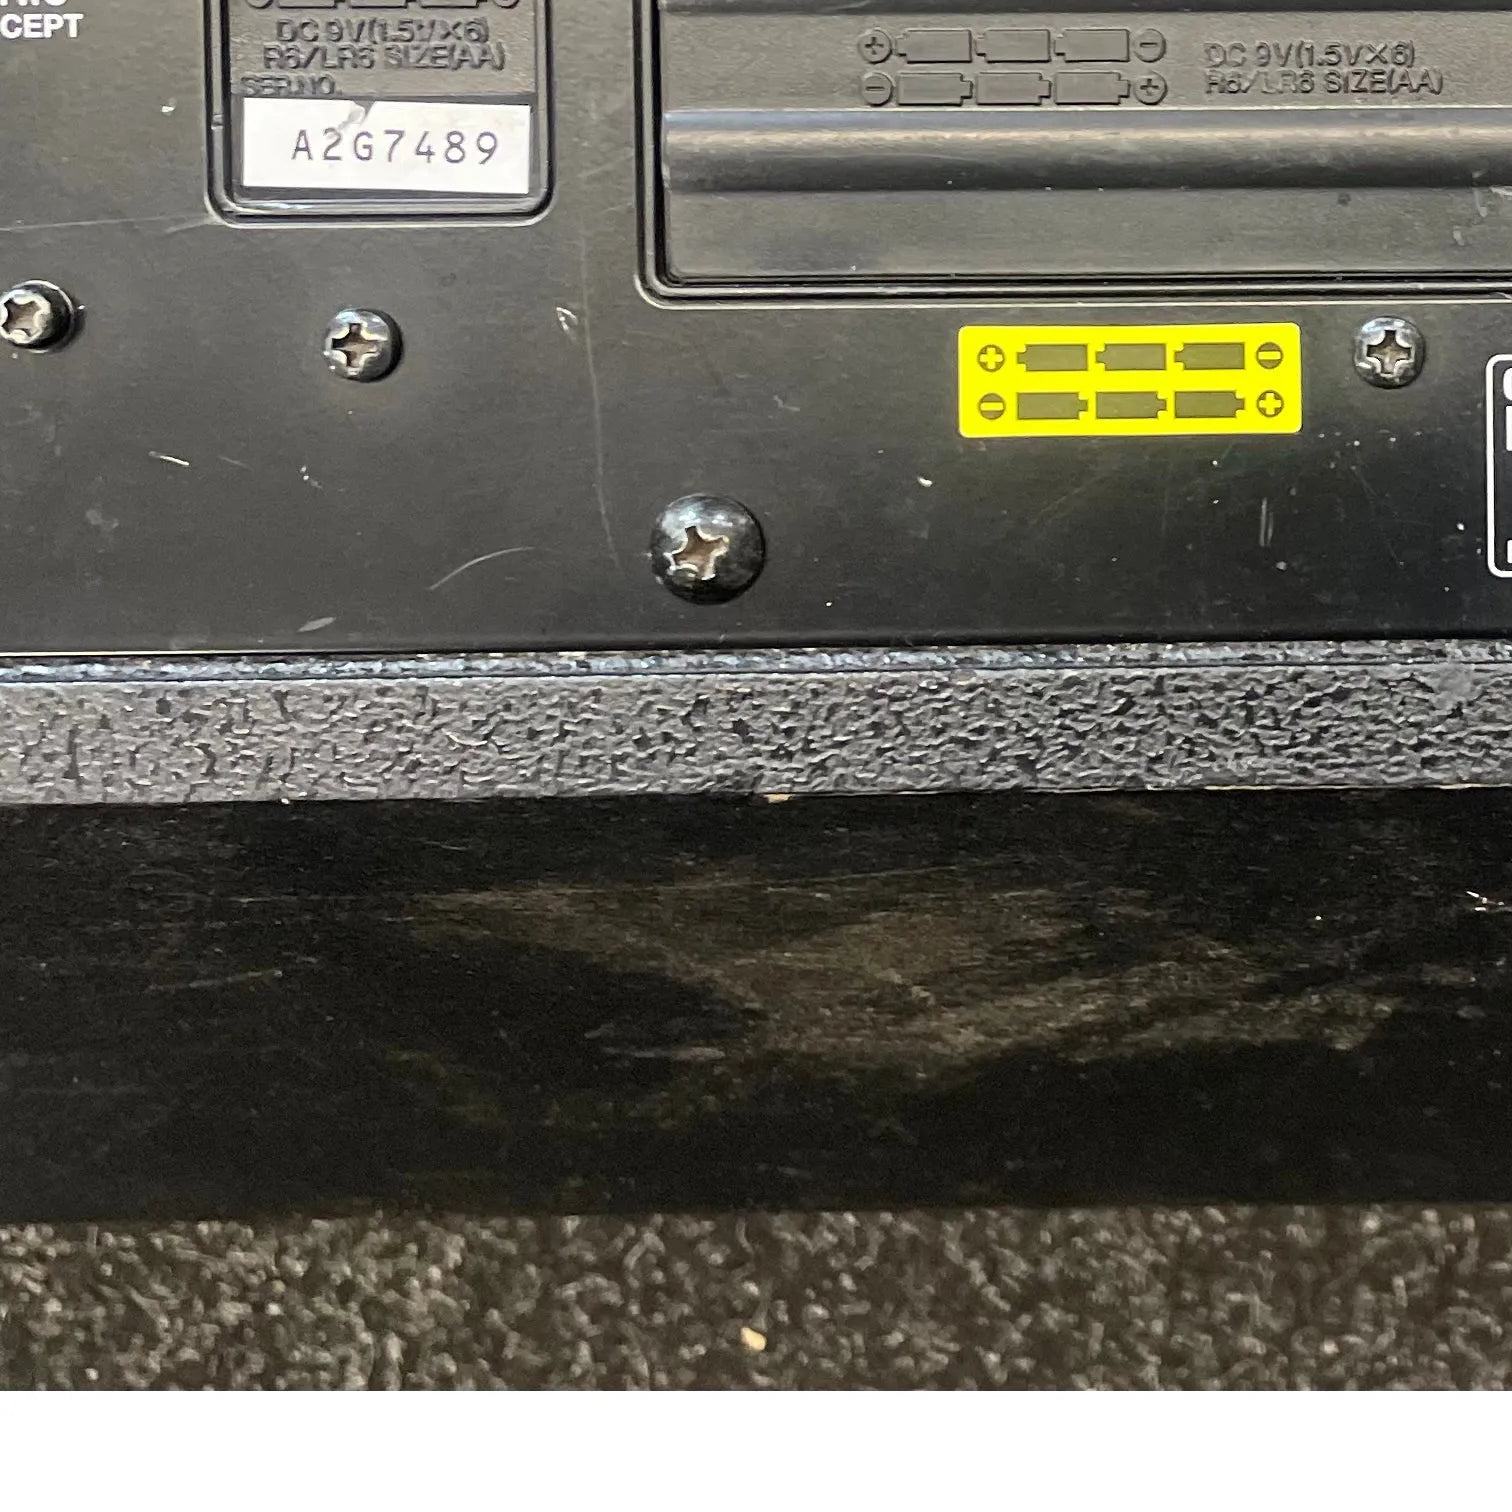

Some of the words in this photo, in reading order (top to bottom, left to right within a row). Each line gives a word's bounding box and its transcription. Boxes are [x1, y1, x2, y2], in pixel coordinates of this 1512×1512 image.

[276, 18, 321, 43] DC
[264, 43, 376, 70] R6/LR6
[382, 42, 506, 71] SIZE(AA)
[1204, 42, 1248, 68] DC
[1205, 70, 1315, 94] R6/LR6
[1323, 68, 1443, 95] SIZE(AA)
[291, 128, 499, 165] A2G7489
